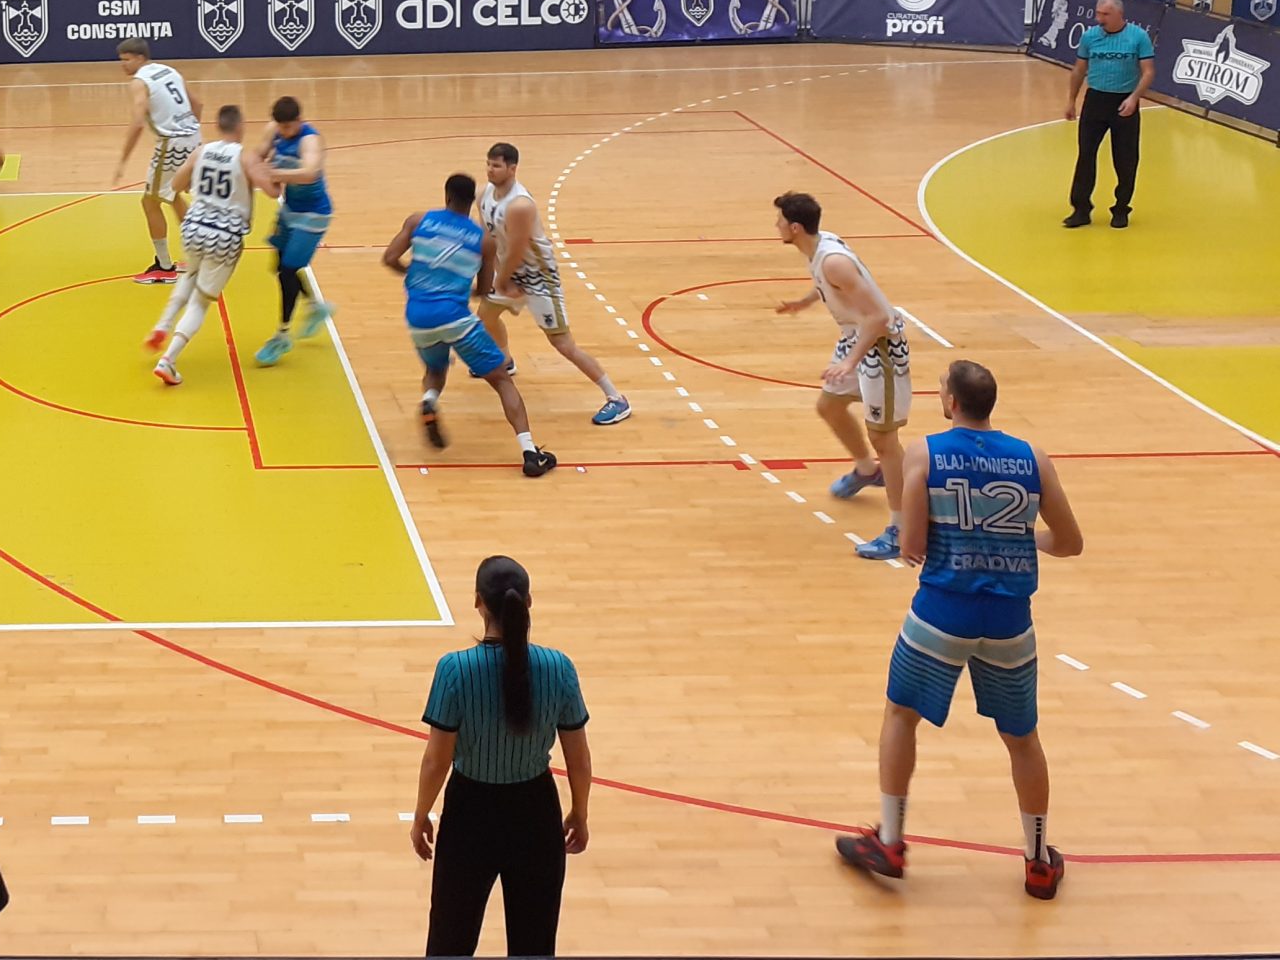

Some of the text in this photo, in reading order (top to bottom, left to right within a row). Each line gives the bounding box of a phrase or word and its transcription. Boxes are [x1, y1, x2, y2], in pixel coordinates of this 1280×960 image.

[98, 0, 140, 17] CSM
[886, 16, 945, 37] profi
[1184, 59, 1250, 94] STIROM
[164, 81, 184, 104] 5
[199, 166, 232, 199] 55
[934, 453, 1033, 476] BLAJ-VOINESCU
[945, 477, 1029, 535] 12
